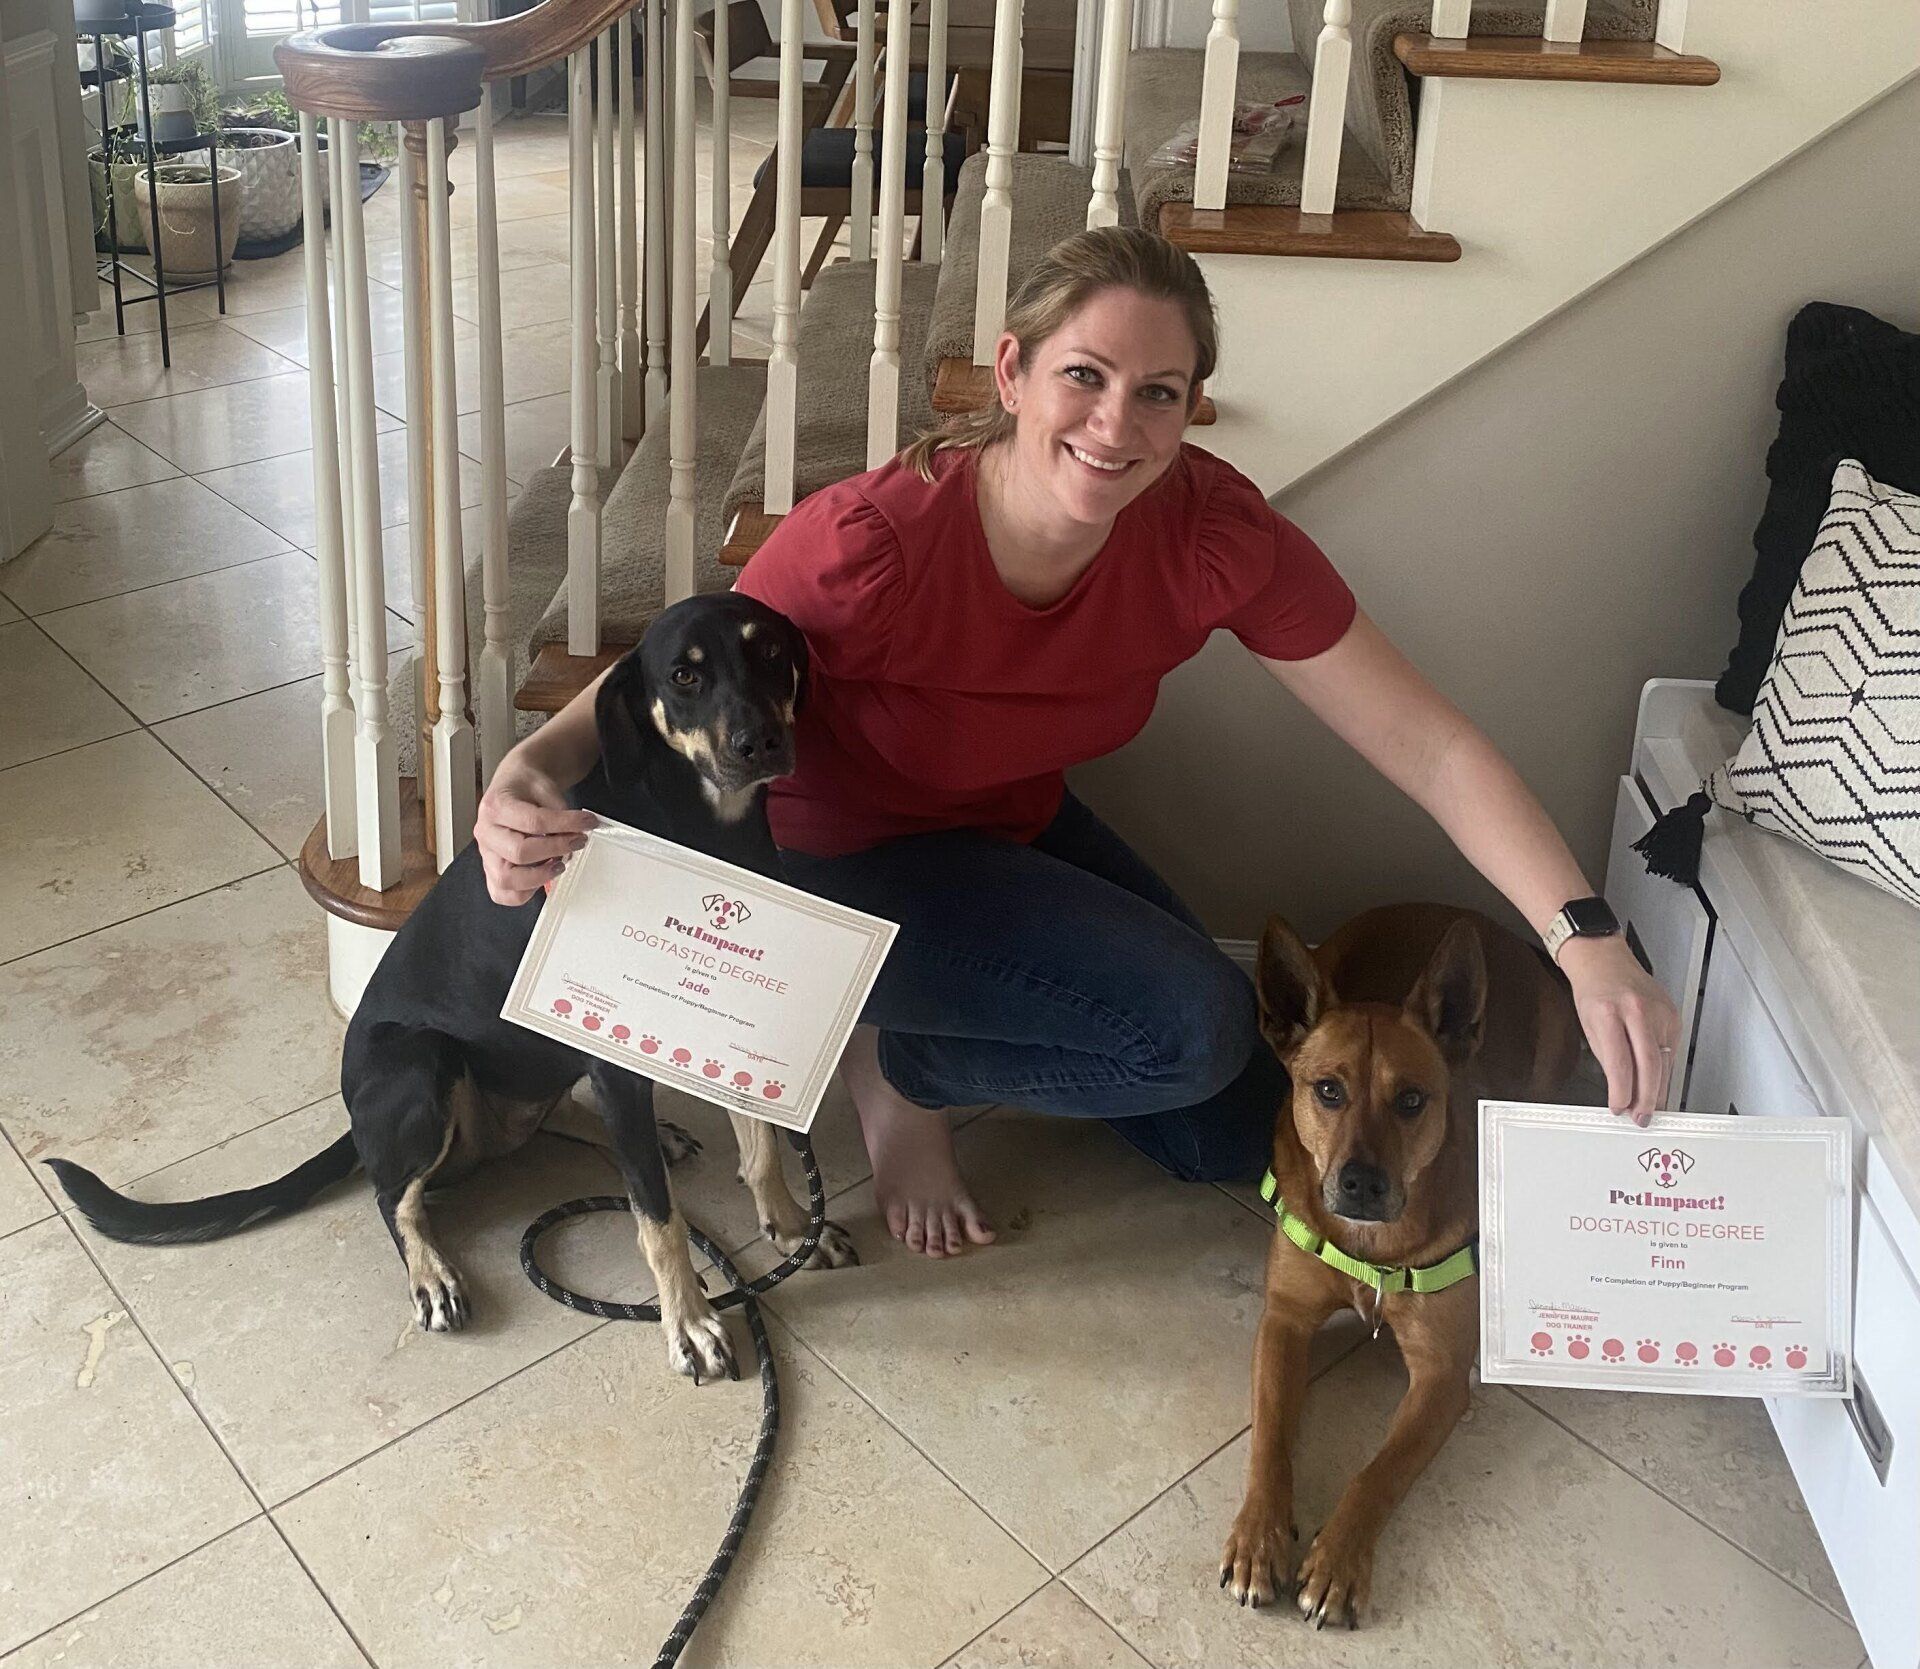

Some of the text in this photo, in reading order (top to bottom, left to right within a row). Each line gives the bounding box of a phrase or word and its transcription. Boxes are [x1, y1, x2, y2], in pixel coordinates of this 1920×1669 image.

[664, 915, 765, 962] PetImpact!
[622, 924, 789, 995] DOGTASTIC DEGREE
[684, 964, 691, 972] is
[691, 967, 710, 979] given
[678, 977, 710, 996] Jade
[567, 985, 594, 1000] JENNIFER
[594, 995, 618, 1009] MAURER
[571, 994, 610, 1014] DOG TRAINER
[622, 974, 633, 982] For
[634, 979, 670, 997] Completion
[678, 995, 728, 1018] Puppy/Beginner
[728, 1014, 755, 1029] Program
[1609, 1189, 1725, 1212] PetImpact!
[1569, 1216, 1765, 1240] DOGTASTIC DEGREE
[1658, 1242, 1679, 1250] given
[1651, 1255, 1685, 1270] Finn
[1590, 1275, 1602, 1283] For
[1604, 1276, 1646, 1287] Completion
[1657, 1280, 1716, 1291] Puppy/Beginner
[1717, 1282, 1749, 1292] Program
[1539, 1312, 1570, 1321] JENNIFER
[1563, 1323, 1593, 1331] TRAINER
